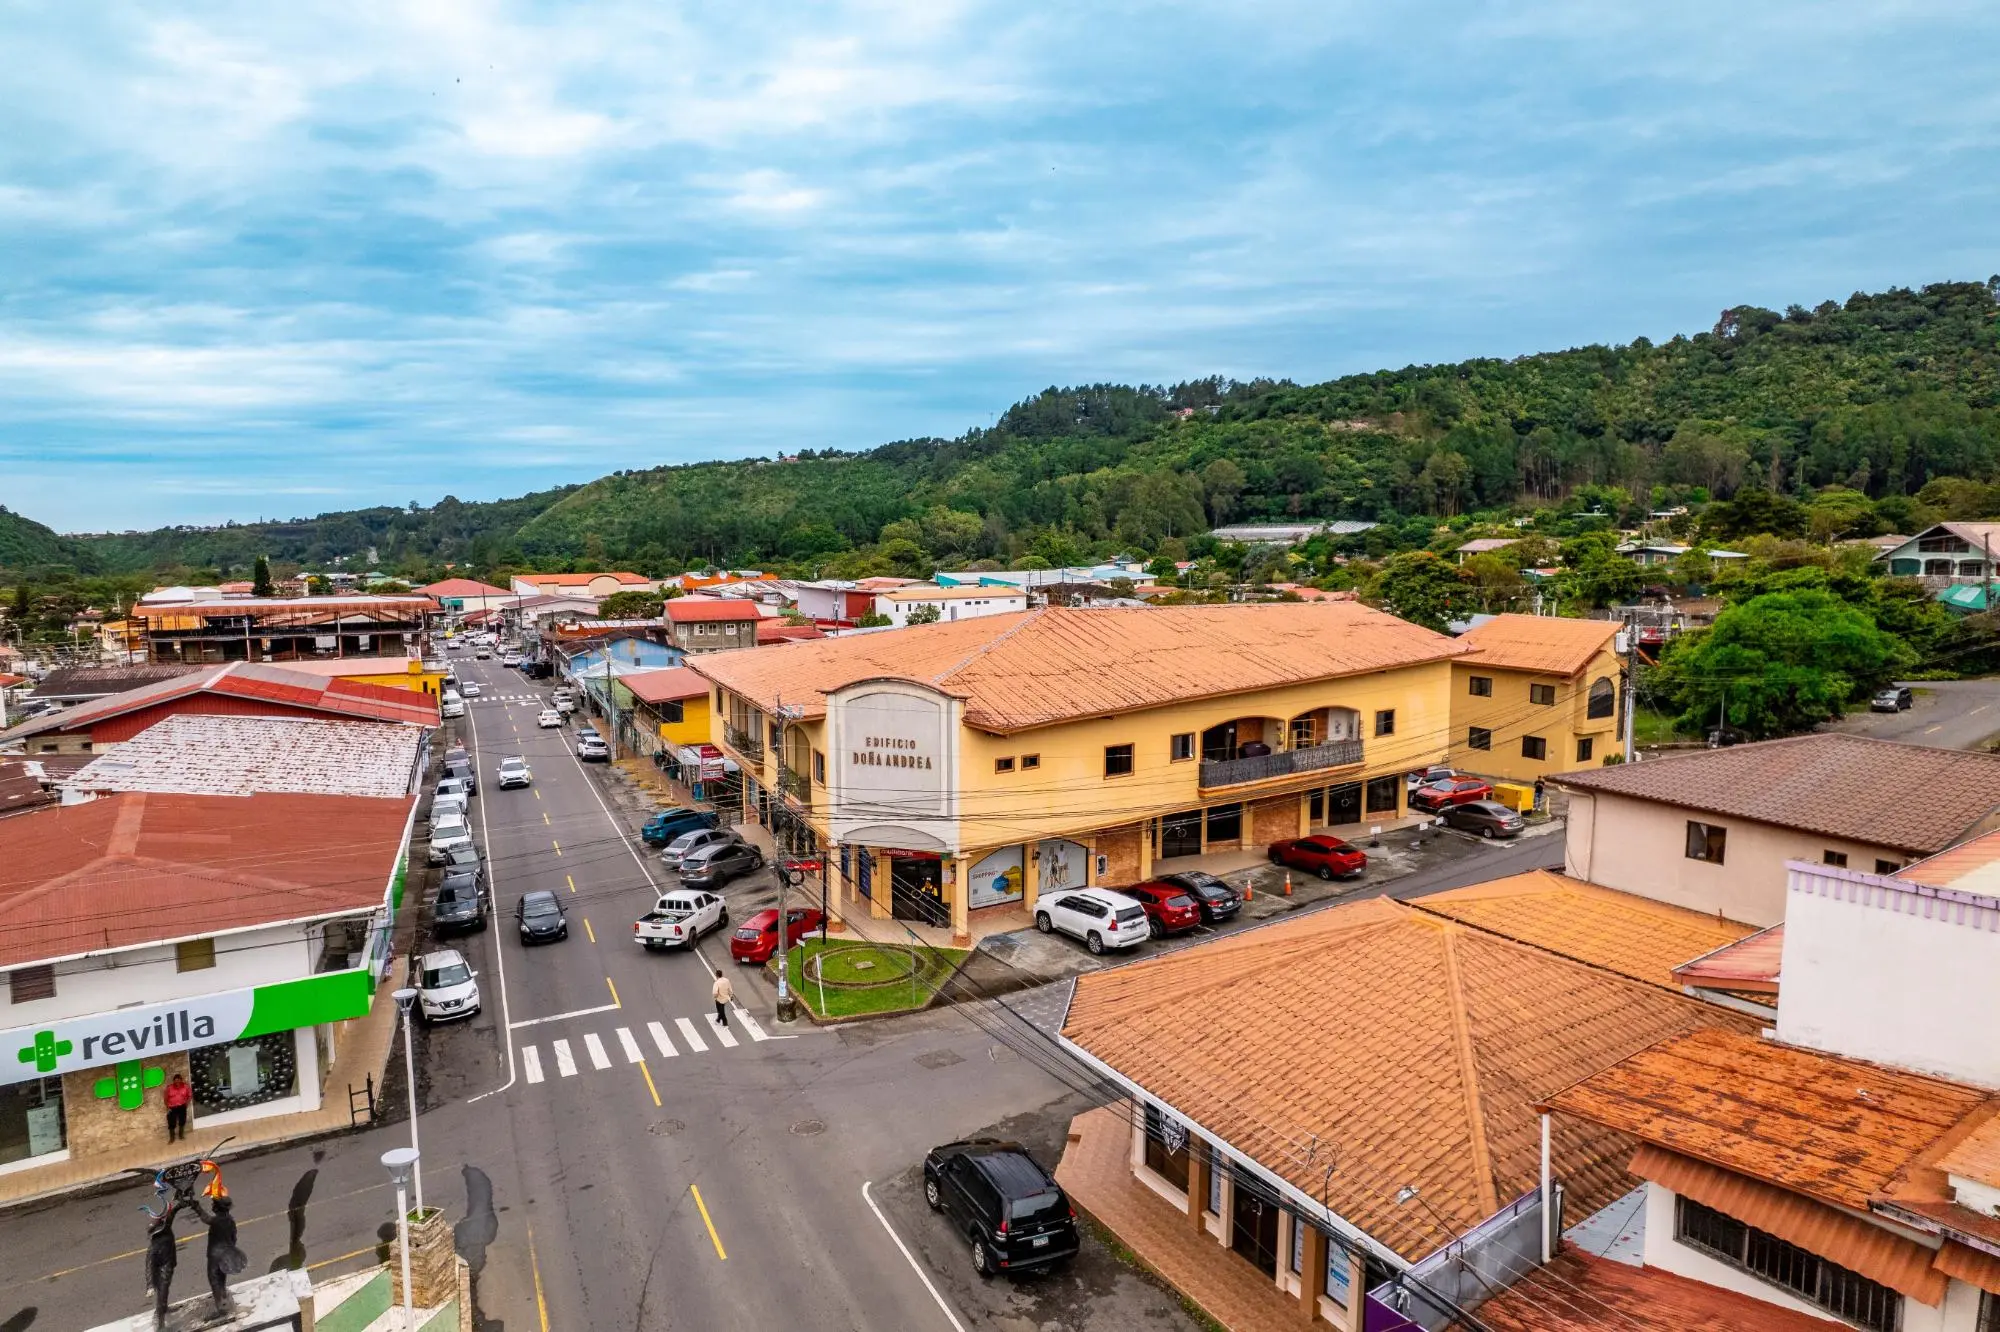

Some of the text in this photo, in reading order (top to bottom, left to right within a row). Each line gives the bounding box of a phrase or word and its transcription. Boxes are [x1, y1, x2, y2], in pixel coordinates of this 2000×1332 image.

[865, 736, 916, 750] EDIFICIO
[853, 751, 932, 770] DOÑA ANDREA
[82, 1009, 215, 1060] revilla
